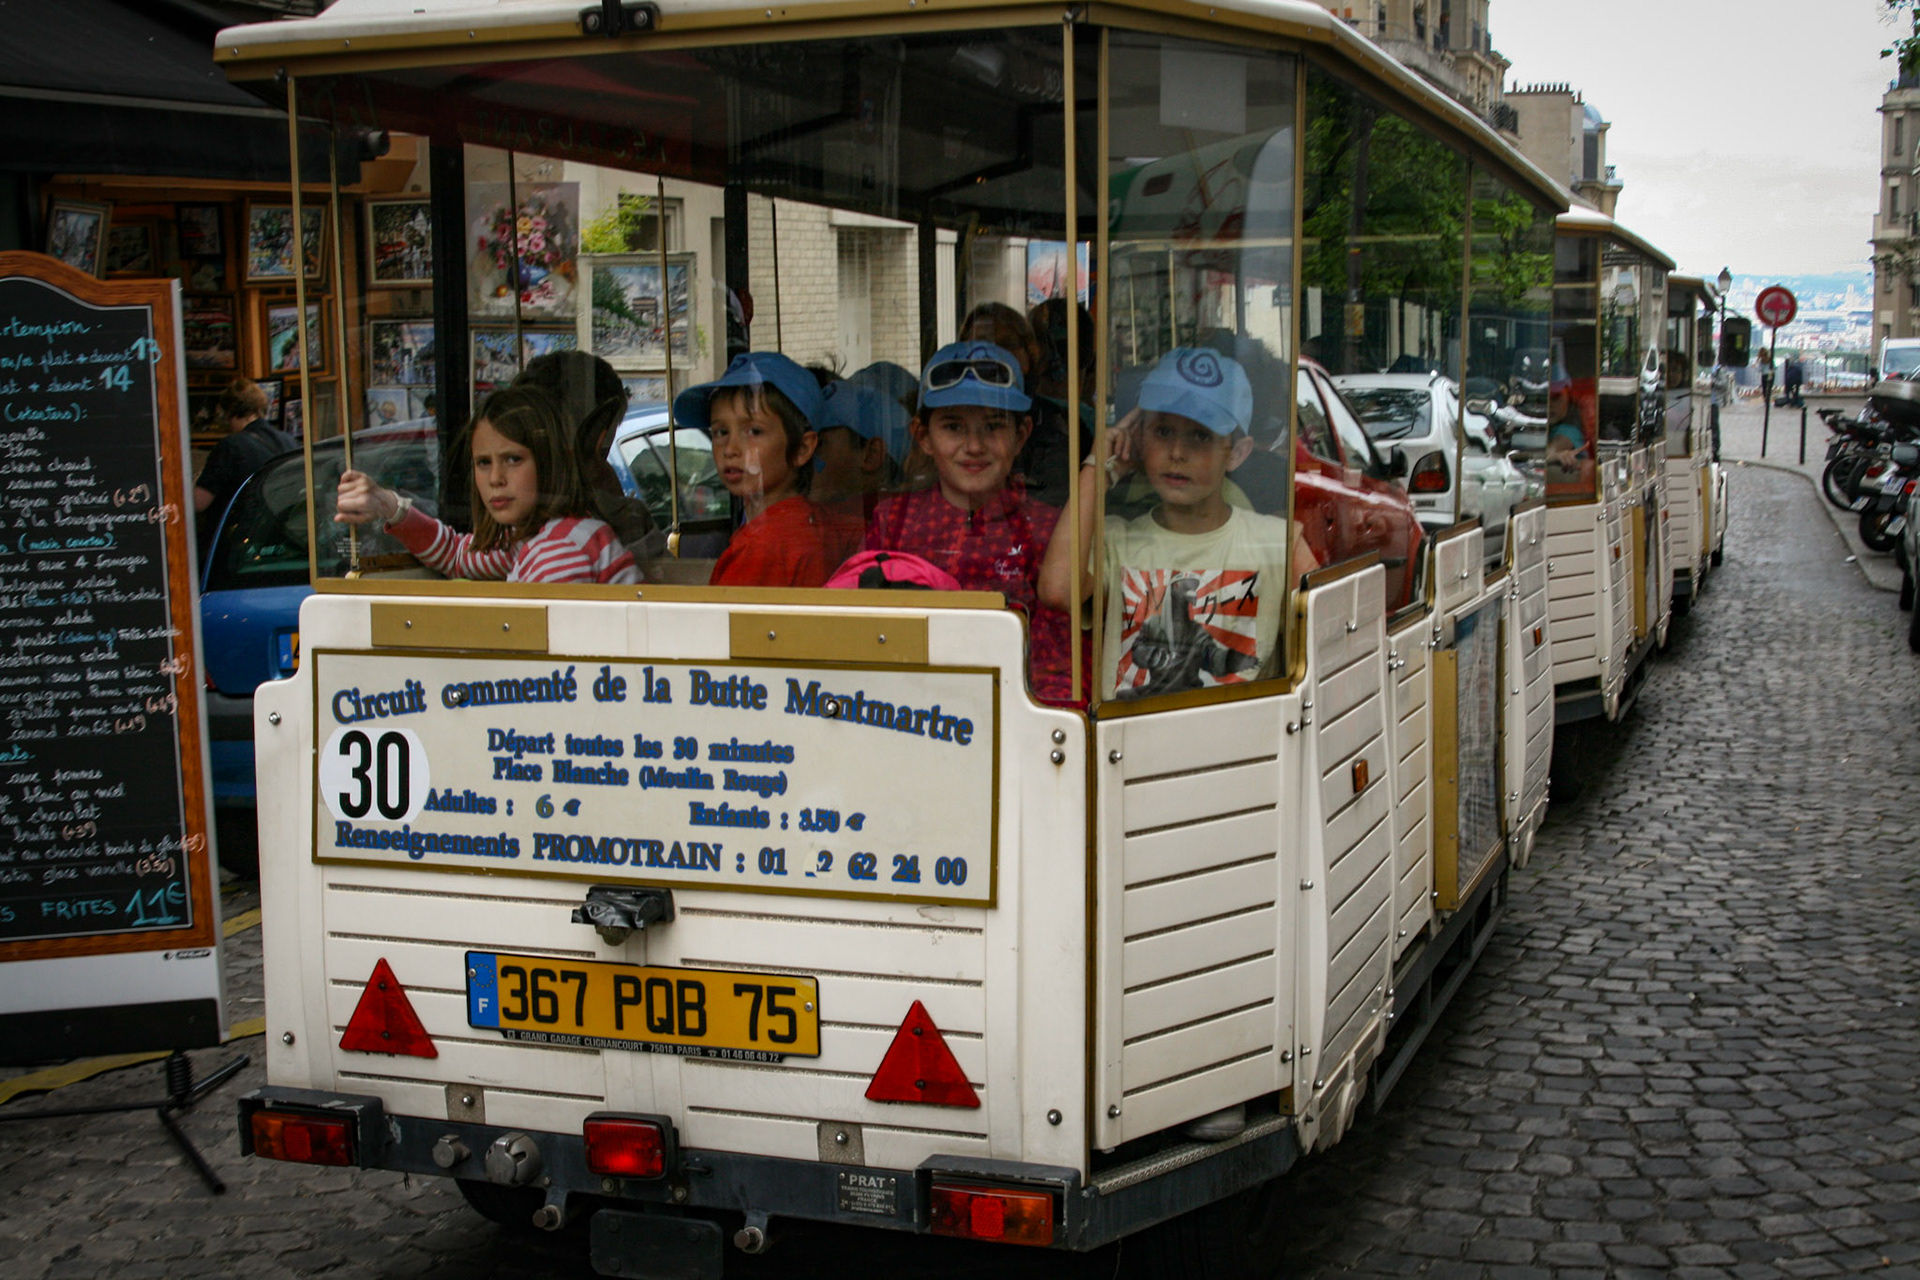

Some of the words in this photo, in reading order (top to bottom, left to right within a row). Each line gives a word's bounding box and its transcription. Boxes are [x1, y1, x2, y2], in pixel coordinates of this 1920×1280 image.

[99, 364, 134, 392] 14
[74, 554, 89, 569] 4
[332, 679, 427, 724] Circuit
[593, 665, 627, 702] de
[643, 666, 672, 703] la
[689, 670, 768, 710] Butte
[487, 728, 555, 759] Départ
[565, 733, 625, 758] toutes
[634, 734, 664, 759] les
[673, 737, 699, 761] 30
[708, 738, 795, 764] minutes
[338, 730, 410, 820] 30
[492, 756, 543, 783] Place
[551, 759, 630, 786] Blanche
[639, 766, 714, 790] (Moulin
[723, 769, 788, 798] Rouge)
[424, 788, 498, 815] Adultes
[535, 793, 555, 818] 6
[689, 802, 770, 829] Enfants
[335, 820, 520, 859] Renseignements
[533, 832, 722, 871] PROMOTRAIN
[758, 847, 788, 875] 01
[847, 852, 878, 881] 62
[891, 854, 921, 883] 24
[935, 857, 967, 886] 00
[478, 997, 489, 1014] F
[500, 965, 588, 1027] 367
[613, 974, 707, 1037] PQB
[733, 983, 797, 1044] 75
[520, 1031, 547, 1043] GRAND
[550, 1034, 581, 1047] GARAGE
[584, 1038, 644, 1051] CLIGNANCOURT
[650, 1044, 673, 1055] 75018
[676, 1046, 702, 1057] PARIS
[849, 1174, 886, 1188] PRAT
